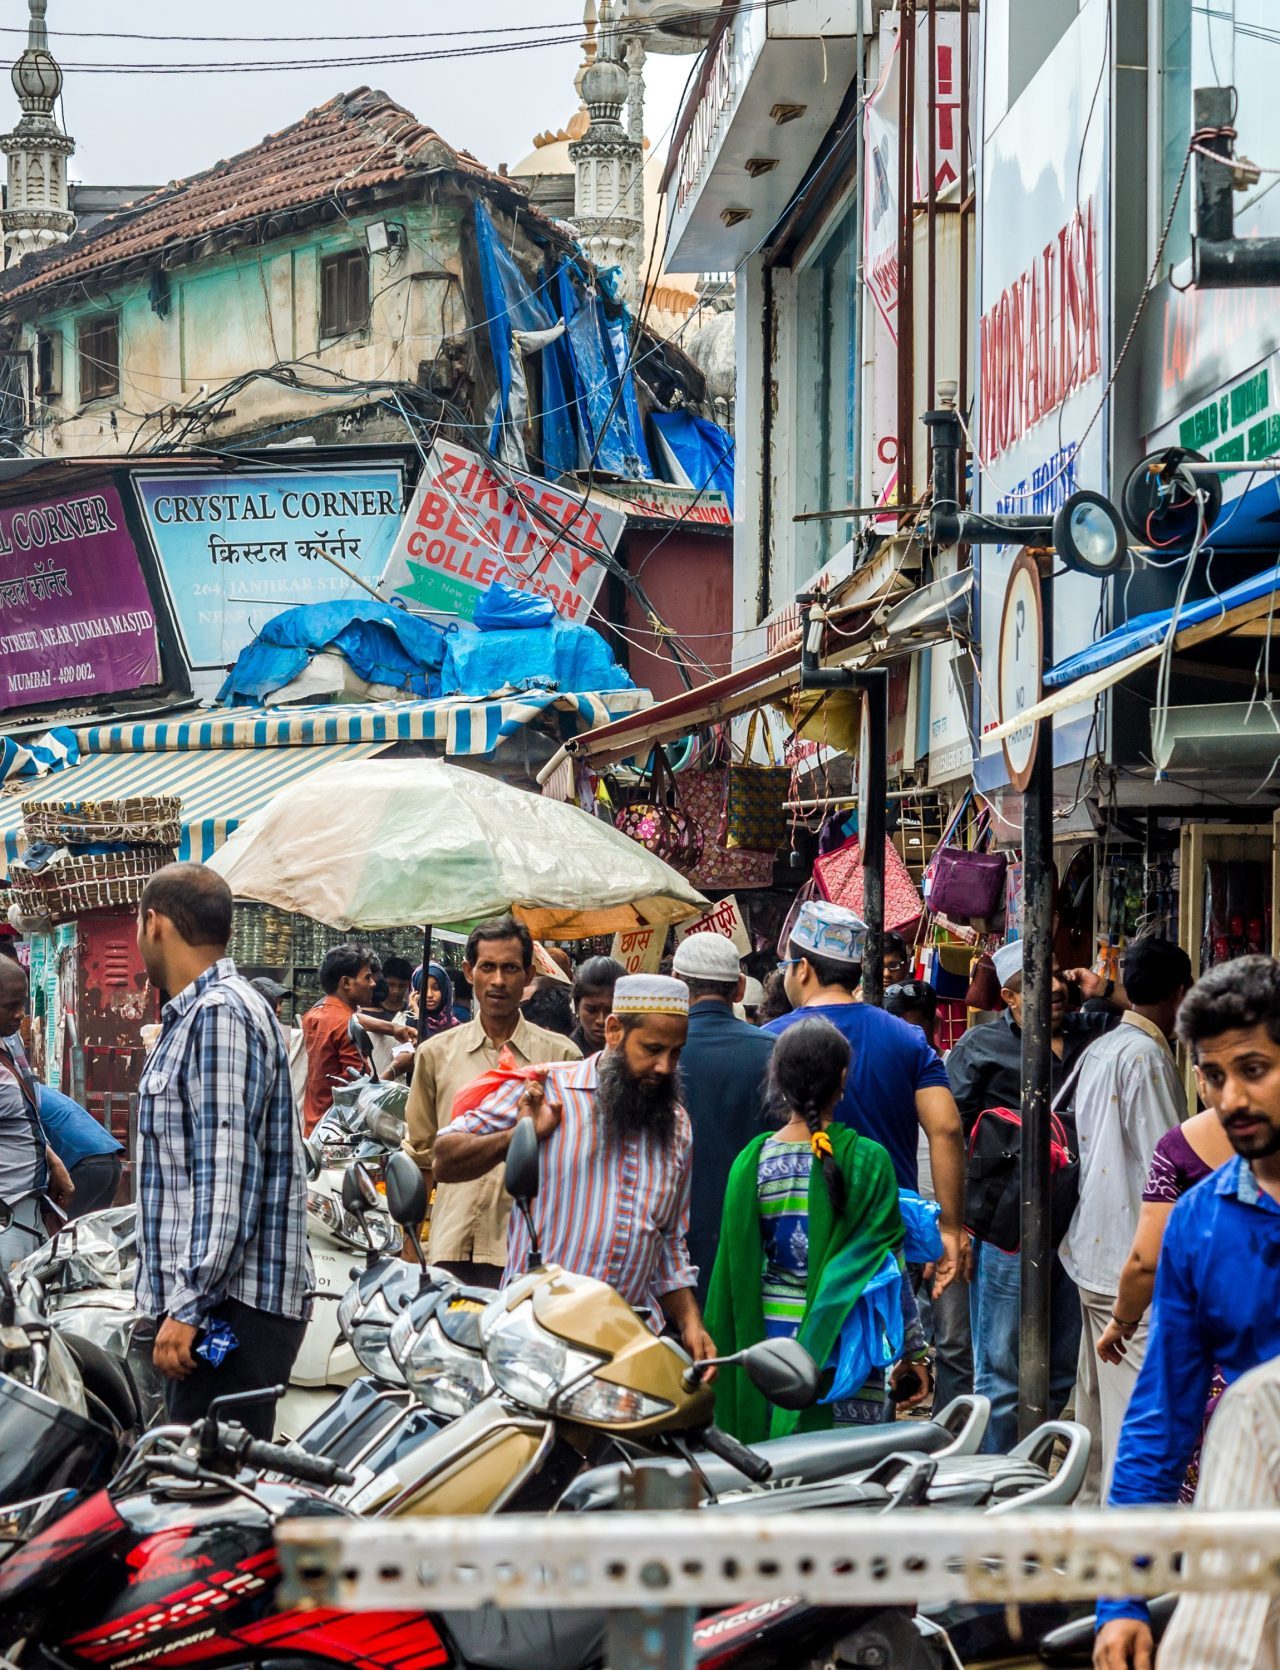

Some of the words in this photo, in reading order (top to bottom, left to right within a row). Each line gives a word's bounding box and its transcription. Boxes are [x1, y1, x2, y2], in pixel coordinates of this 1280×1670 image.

[979, 194, 1100, 472] MONALISA
[154, 494, 276, 524] CRYSTAL
[281, 489, 400, 519] CORNER
[432, 453, 604, 549] ZIKREEL
[12, 494, 117, 551] CORNER
[416, 491, 597, 588] BEAUTY
[208, 533, 288, 565] क्रिस्टल
[294, 528, 363, 561] कॉर्नर
[230, 577, 313, 602] JANJIKAR
[0, 630, 45, 656] STREET,
[41, 623, 74, 648] NEAR
[70, 616, 112, 649] JUMMA
[110, 609, 154, 637] MASJID
[199, 610, 248, 624] NEAR
[7, 668, 52, 692] MUMBAI
[57, 668, 77, 684] 400
[74, 662, 96, 682] 002.
[1015, 686, 1025, 712] NO
[621, 929, 655, 953] छास
[128, 1555, 214, 1585] HONDA
